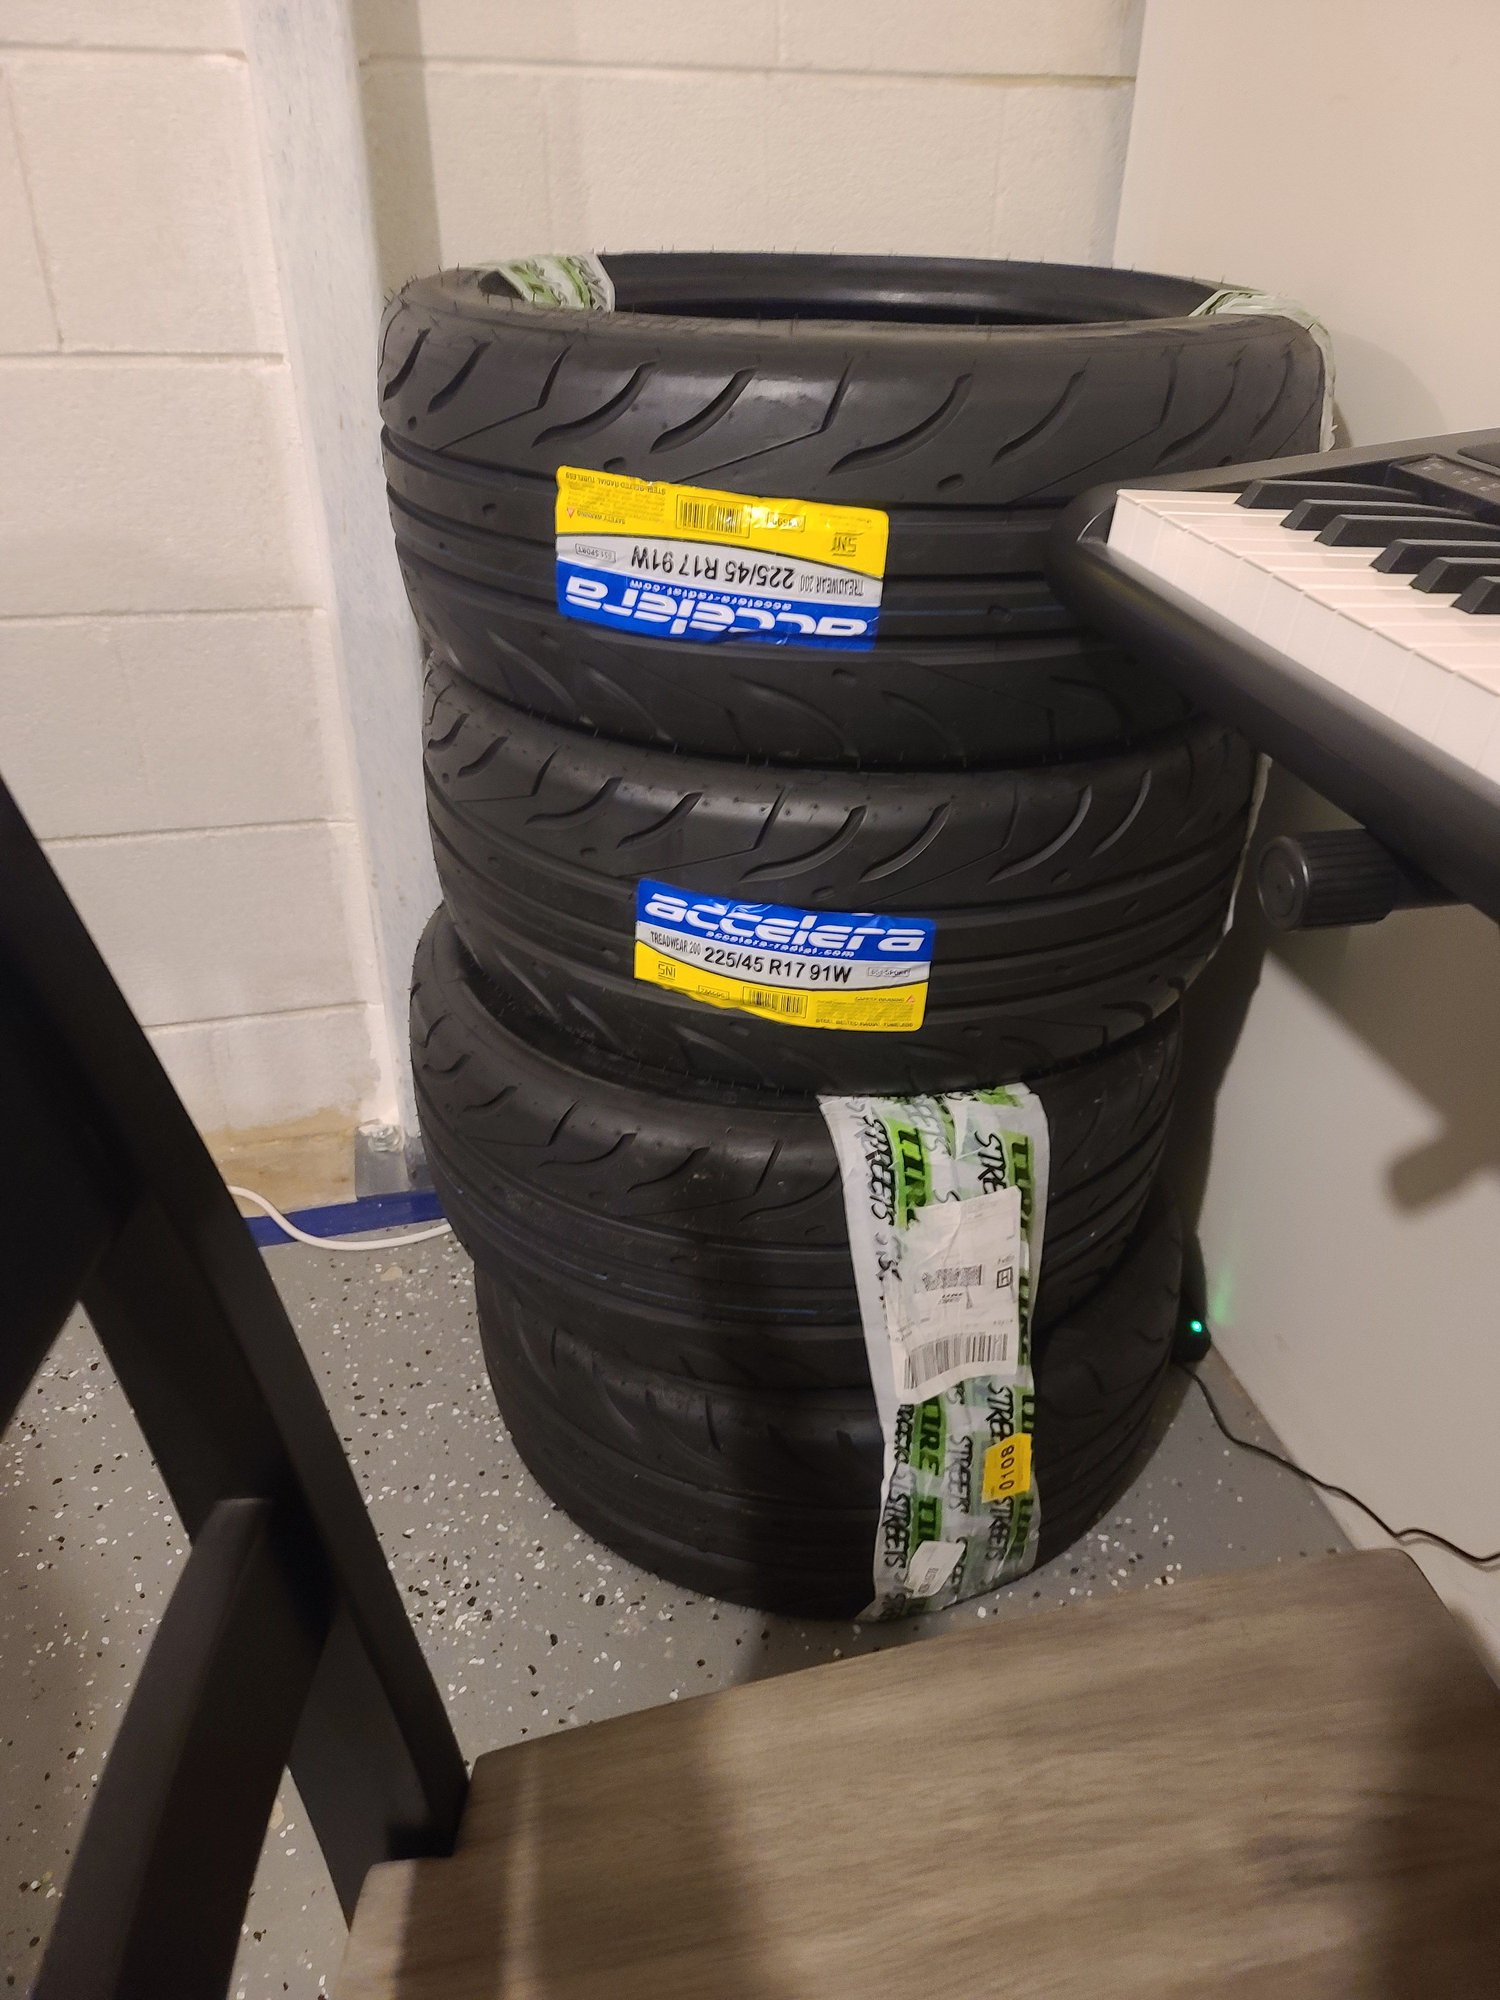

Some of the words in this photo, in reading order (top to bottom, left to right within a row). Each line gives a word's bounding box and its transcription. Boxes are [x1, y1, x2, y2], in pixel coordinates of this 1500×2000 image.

[830, 532, 859, 555] SNI
[630, 544, 673, 574] 91W
[678, 551, 721, 579] R17
[724, 561, 797, 591] 225/45
[797, 573, 814, 594] 200
[812, 575, 866, 598] TREADWEAR
[564, 574, 869, 639] accelera
[627, 578, 794, 612] accelera-radial.com
[643, 891, 926, 953] accelera
[649, 931, 689, 954] TREADWEAR
[688, 940, 702, 956] 200
[703, 946, 766, 974] 225/45
[769, 958, 806, 978] R17
[809, 961, 854, 983] 91W
[705, 930, 856, 959] accelera-radial.com
[657, 962, 676, 980] SNI
[998, 1444, 1016, 1490] 0108
